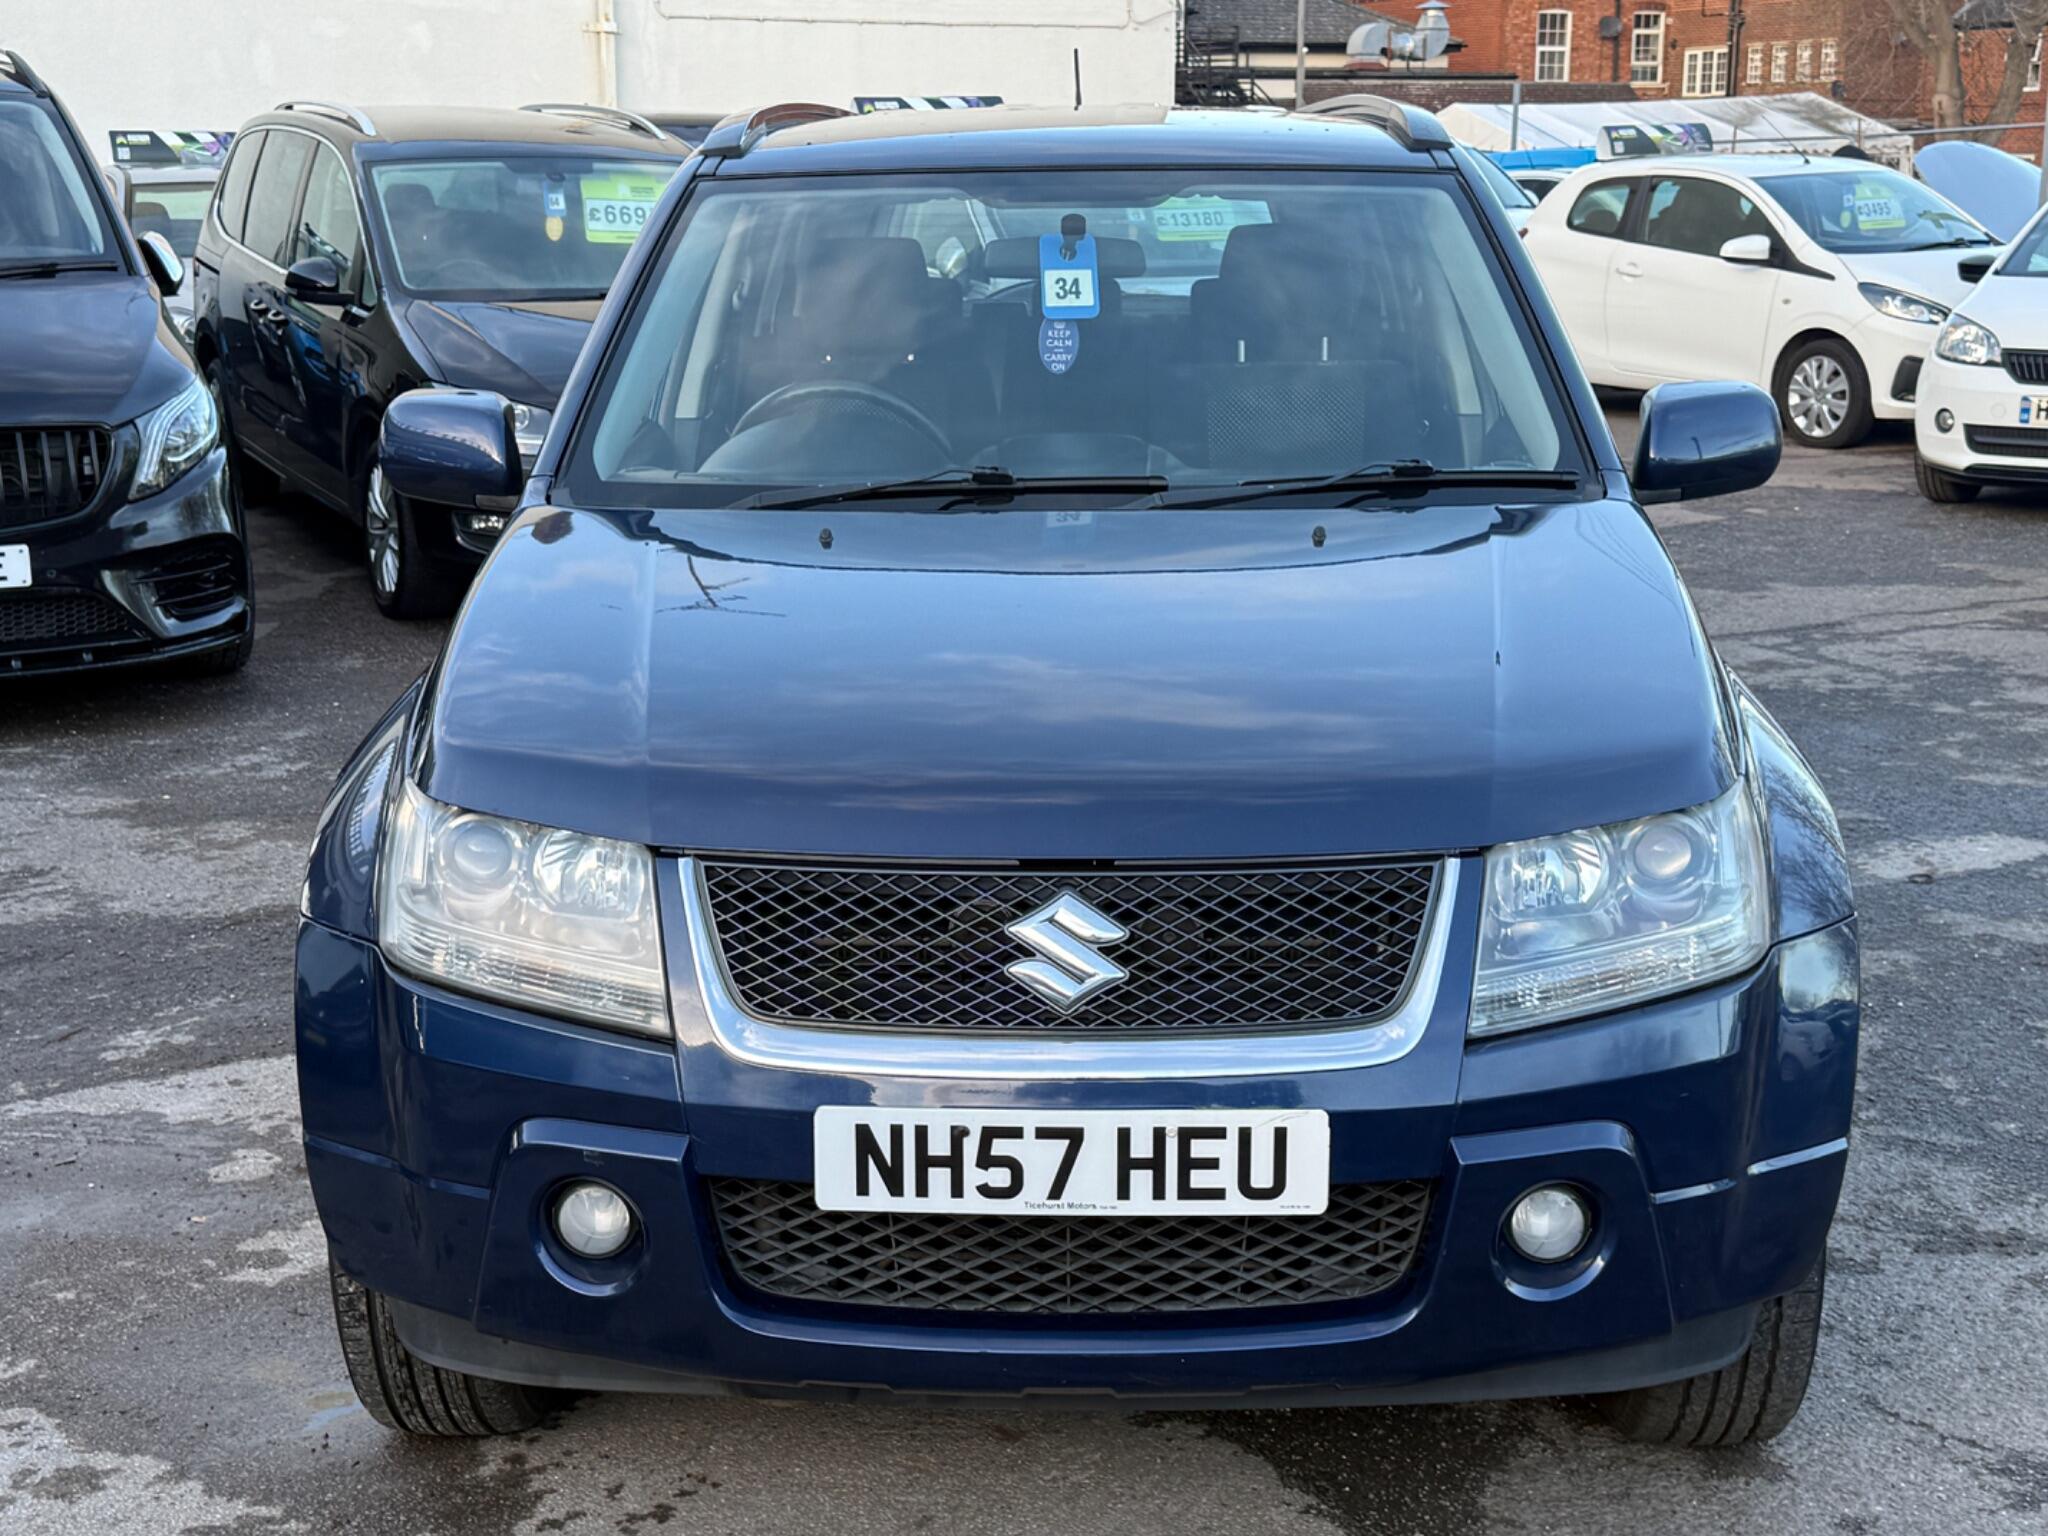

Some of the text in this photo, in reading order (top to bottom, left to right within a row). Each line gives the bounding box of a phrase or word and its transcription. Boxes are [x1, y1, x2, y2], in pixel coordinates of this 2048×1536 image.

[588, 205, 652, 224] £669
[1054, 277, 1082, 300] 34
[1048, 330, 1071, 338] KEEP
[1046, 338, 1072, 347] CALM
[1044, 353, 1072, 361] CARRY
[1051, 363, 1065, 372] ON
[854, 1123, 1288, 1201] NH57 HEU
[1024, 1201, 1065, 1209] Ticehurst
[1067, 1201, 1097, 1210] Motors
